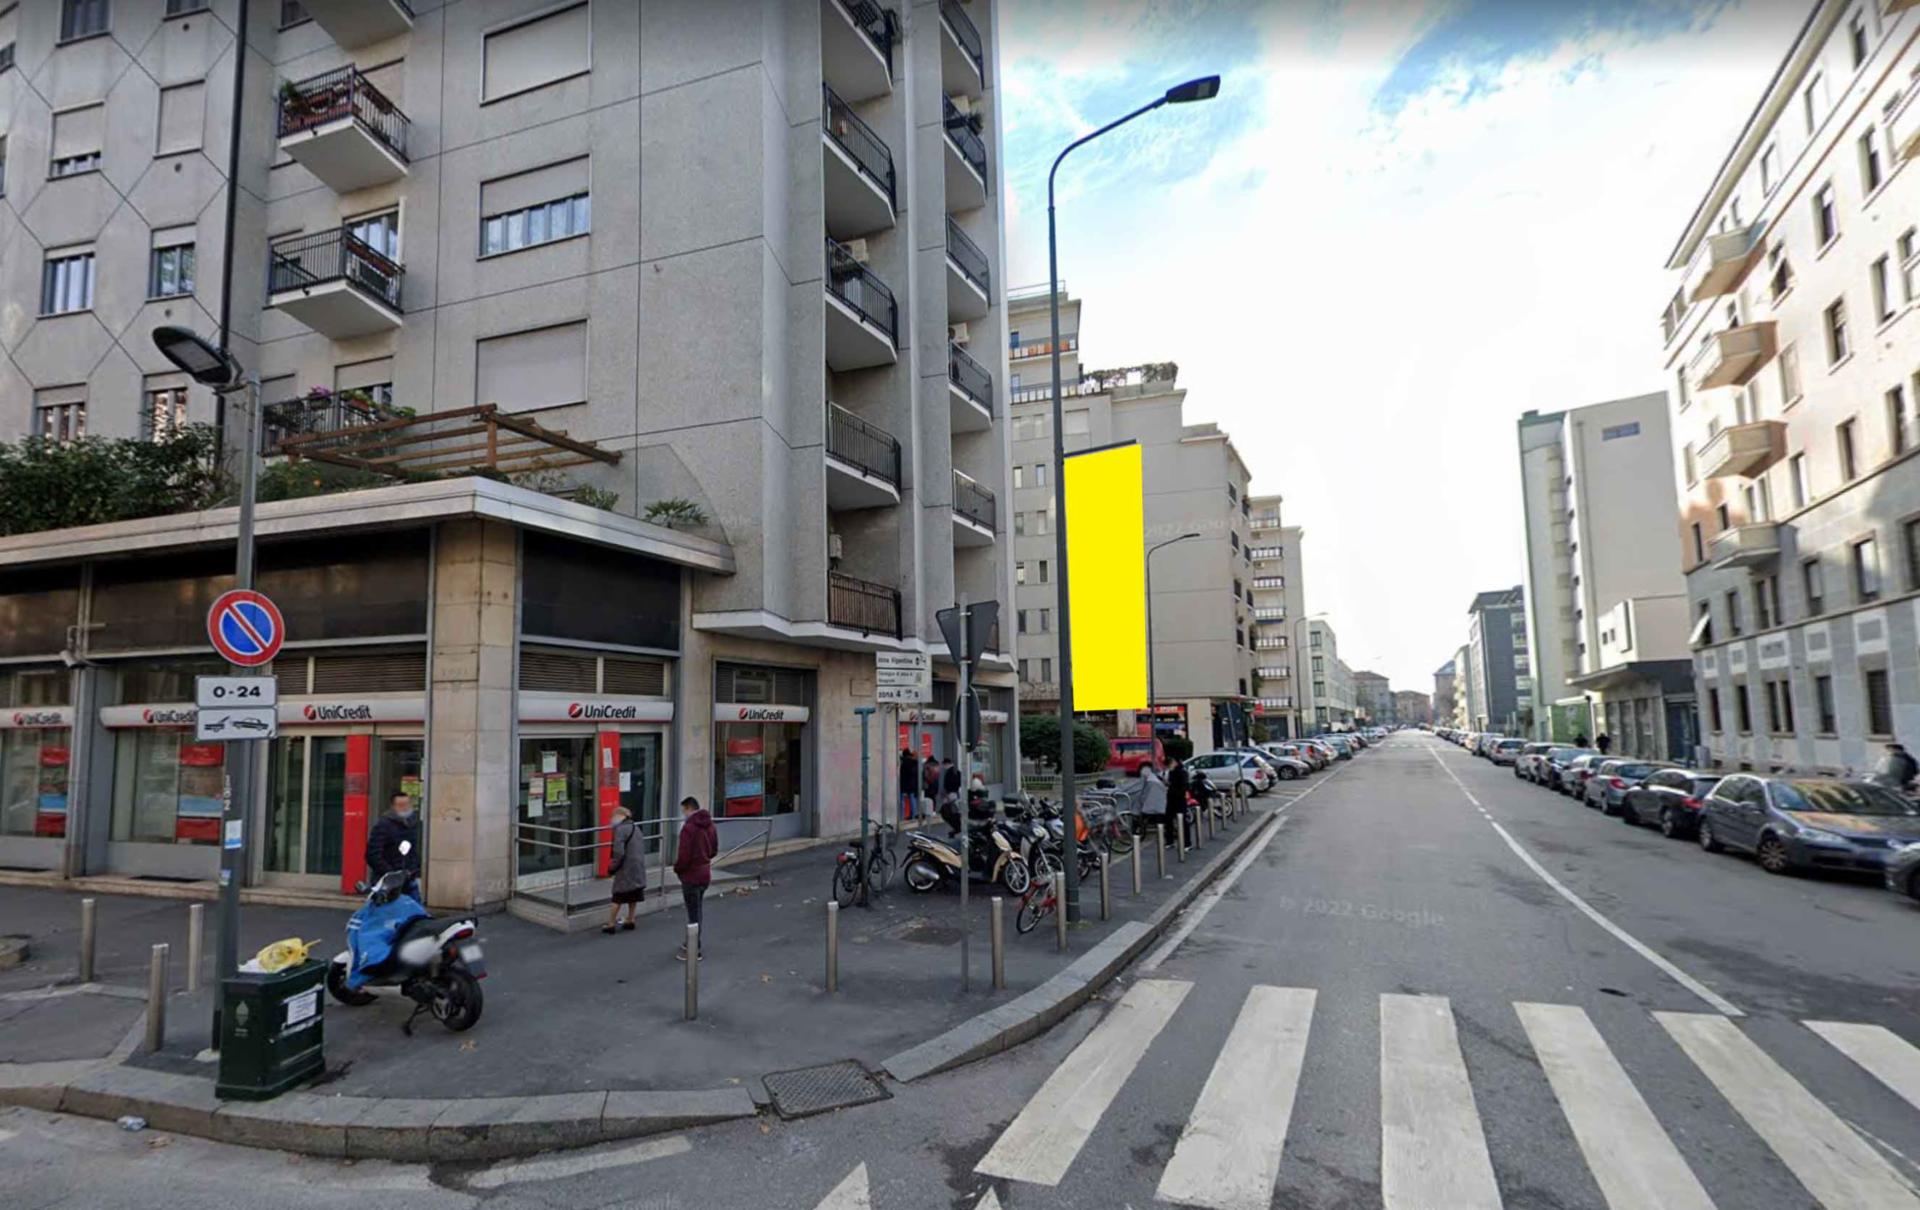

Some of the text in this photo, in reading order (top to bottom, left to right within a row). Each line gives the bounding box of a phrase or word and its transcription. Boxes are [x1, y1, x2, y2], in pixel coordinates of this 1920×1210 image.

[237, 686, 261, 698] 24
[318, 704, 372, 720] UniCredit
[584, 704, 637, 719] UniCredit
[749, 708, 784, 720] UniCredit
